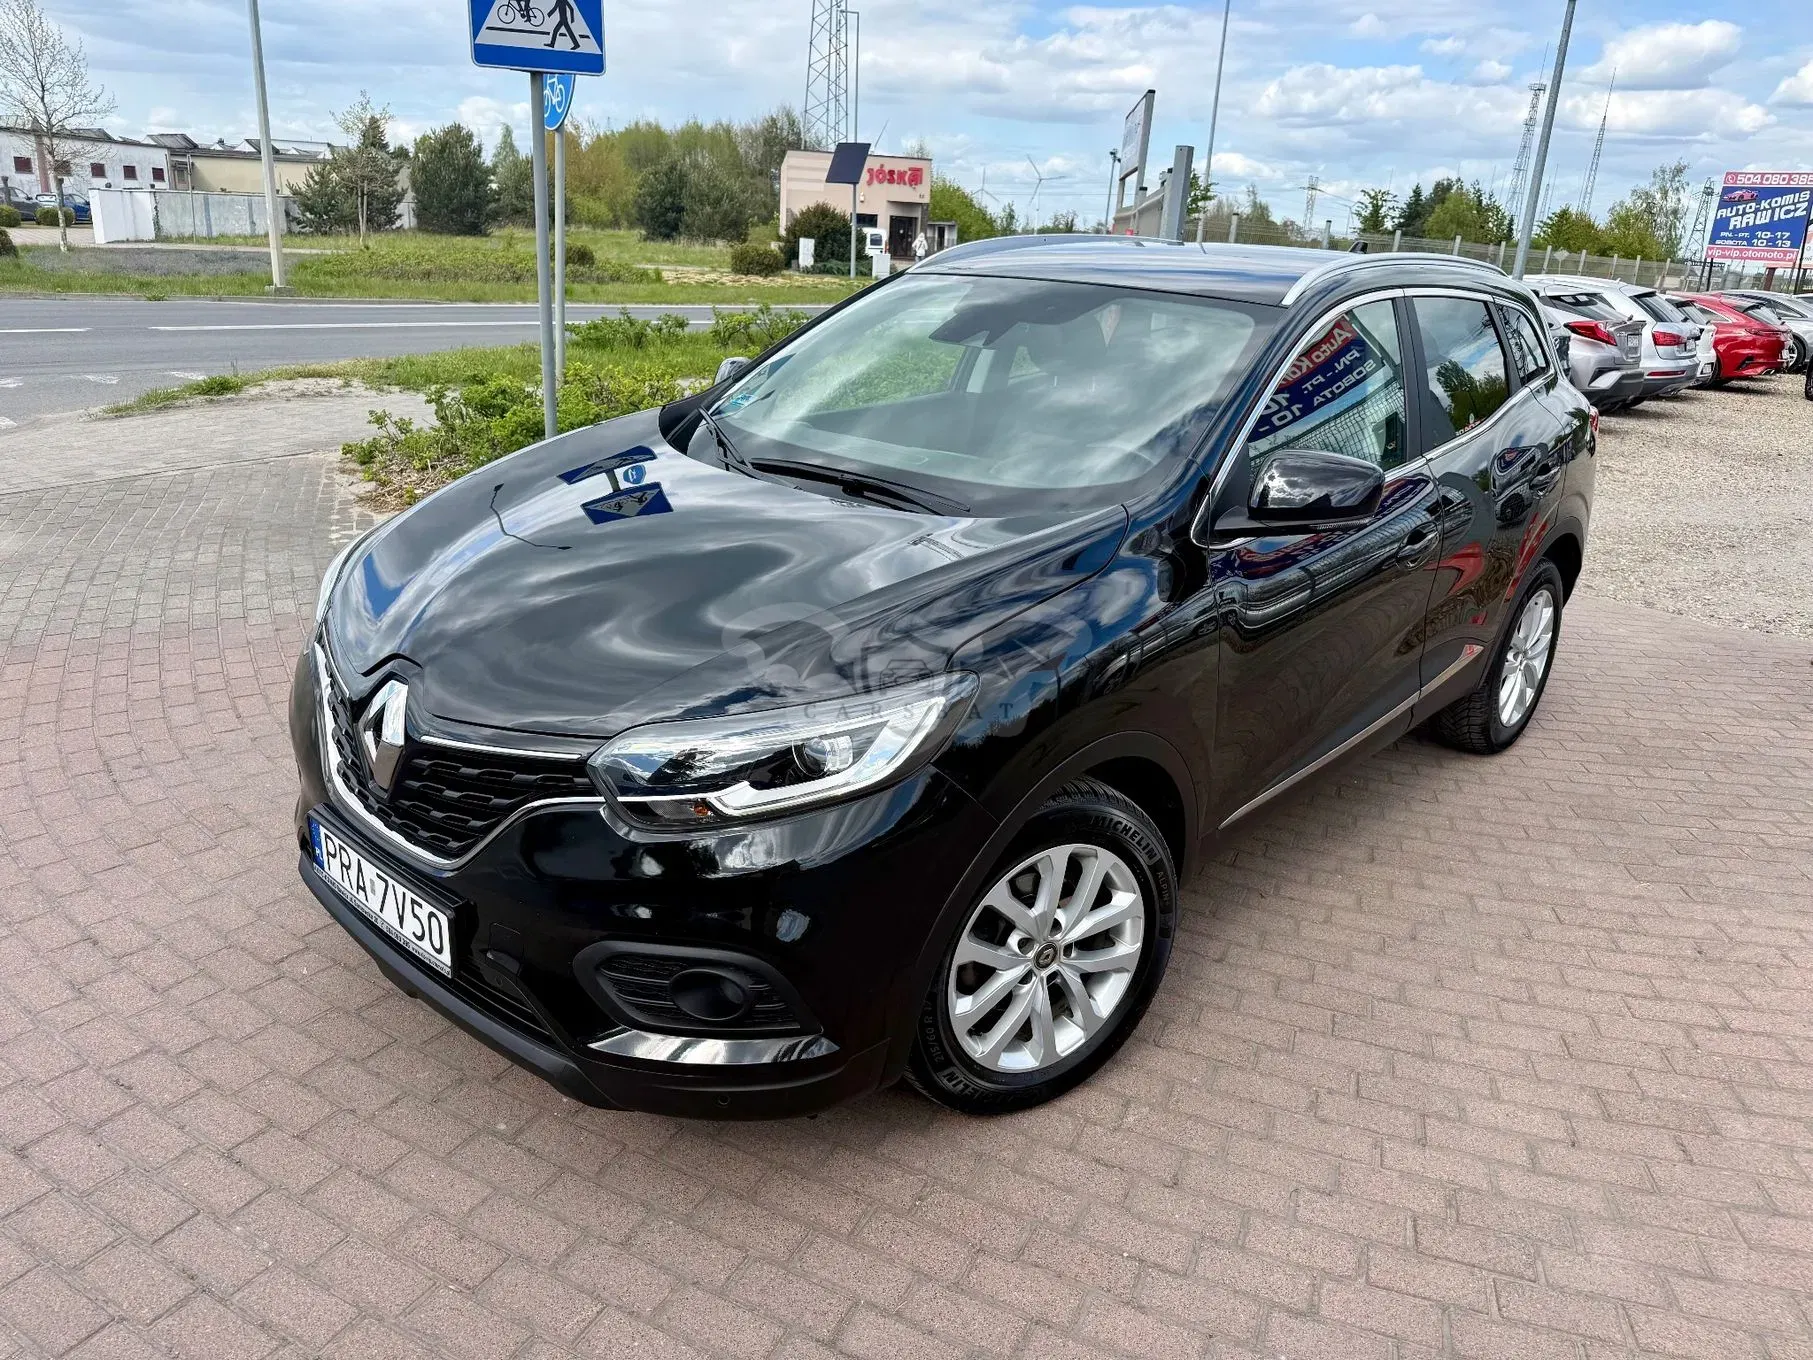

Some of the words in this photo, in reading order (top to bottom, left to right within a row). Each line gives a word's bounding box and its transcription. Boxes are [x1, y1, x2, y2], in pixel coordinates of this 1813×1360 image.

[1736, 174, 1760, 185] 504
[1762, 174, 1788, 185] 080
[1716, 190, 1811, 219] AUTO-KOMIS
[1728, 202, 1809, 230] RAWICZ
[1091, 815, 1158, 861] MICHELIN
